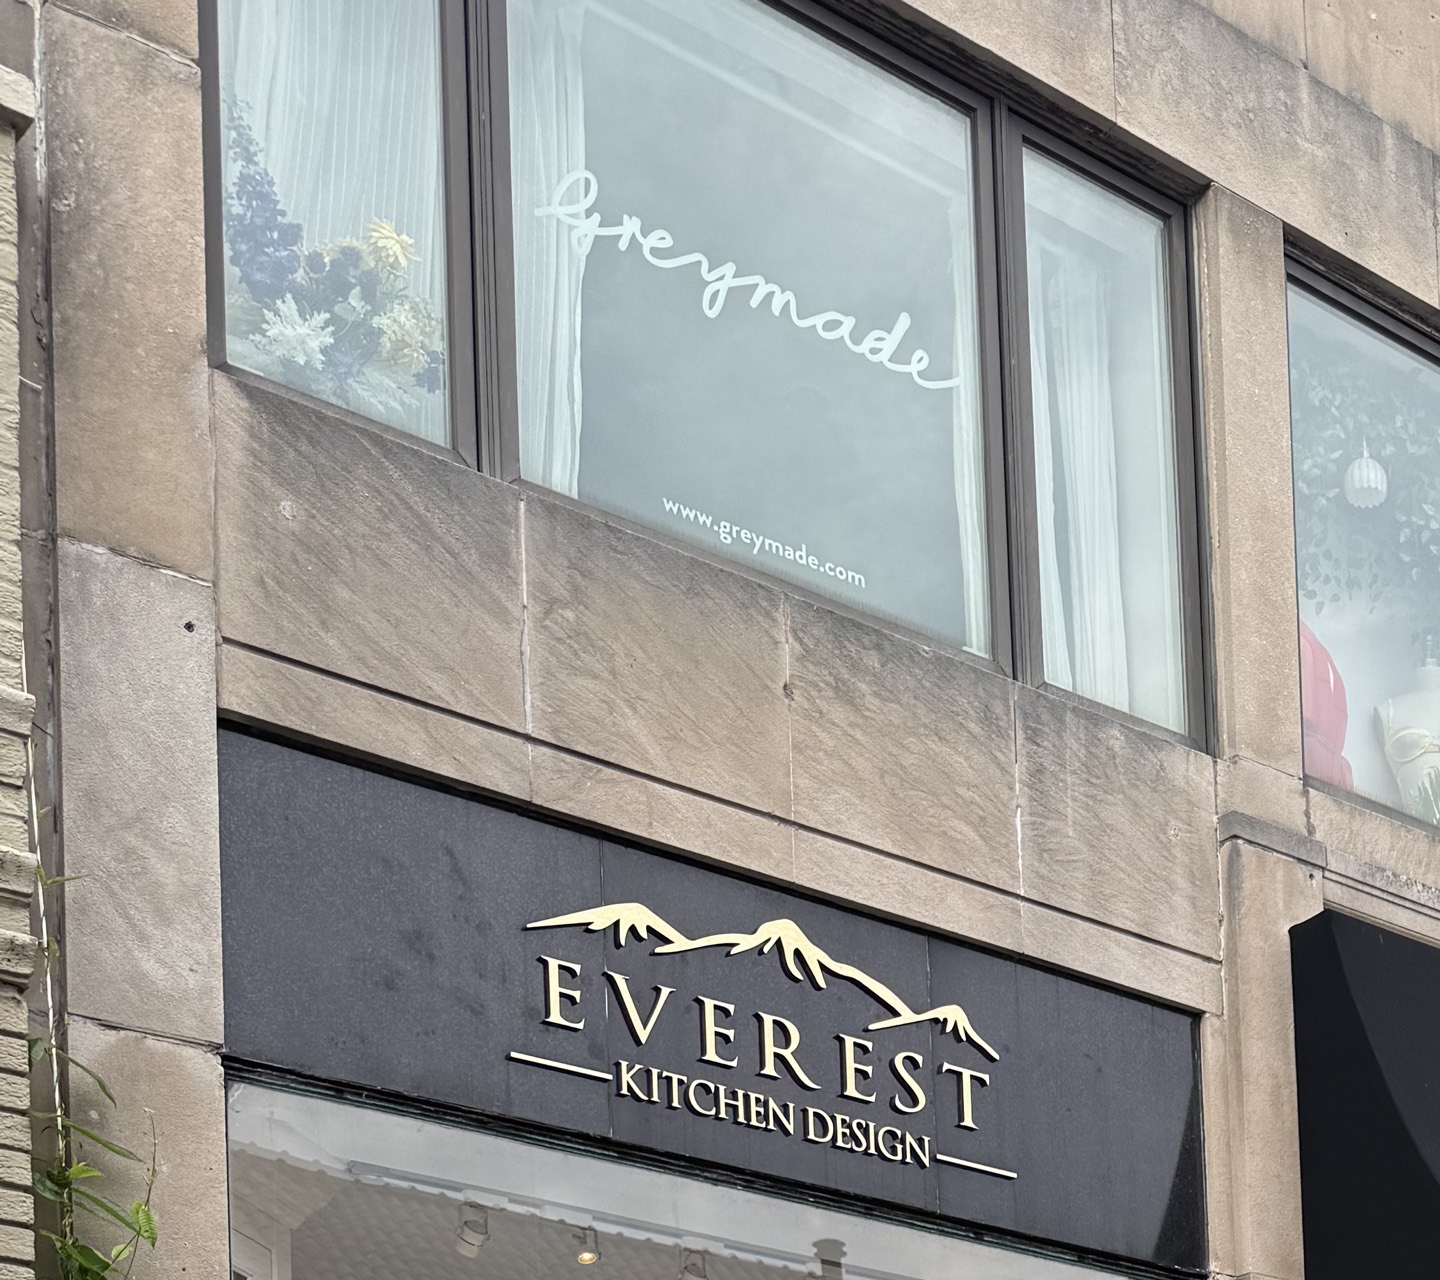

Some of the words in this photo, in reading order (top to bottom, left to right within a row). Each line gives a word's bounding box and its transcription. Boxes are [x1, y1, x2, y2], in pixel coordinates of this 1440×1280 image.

[661, 495, 867, 589] www.greymade.com
[536, 953, 991, 1131] EVEREST
[613, 1058, 795, 1136] KITCHEN
[805, 1106, 931, 1168] DESIGN
